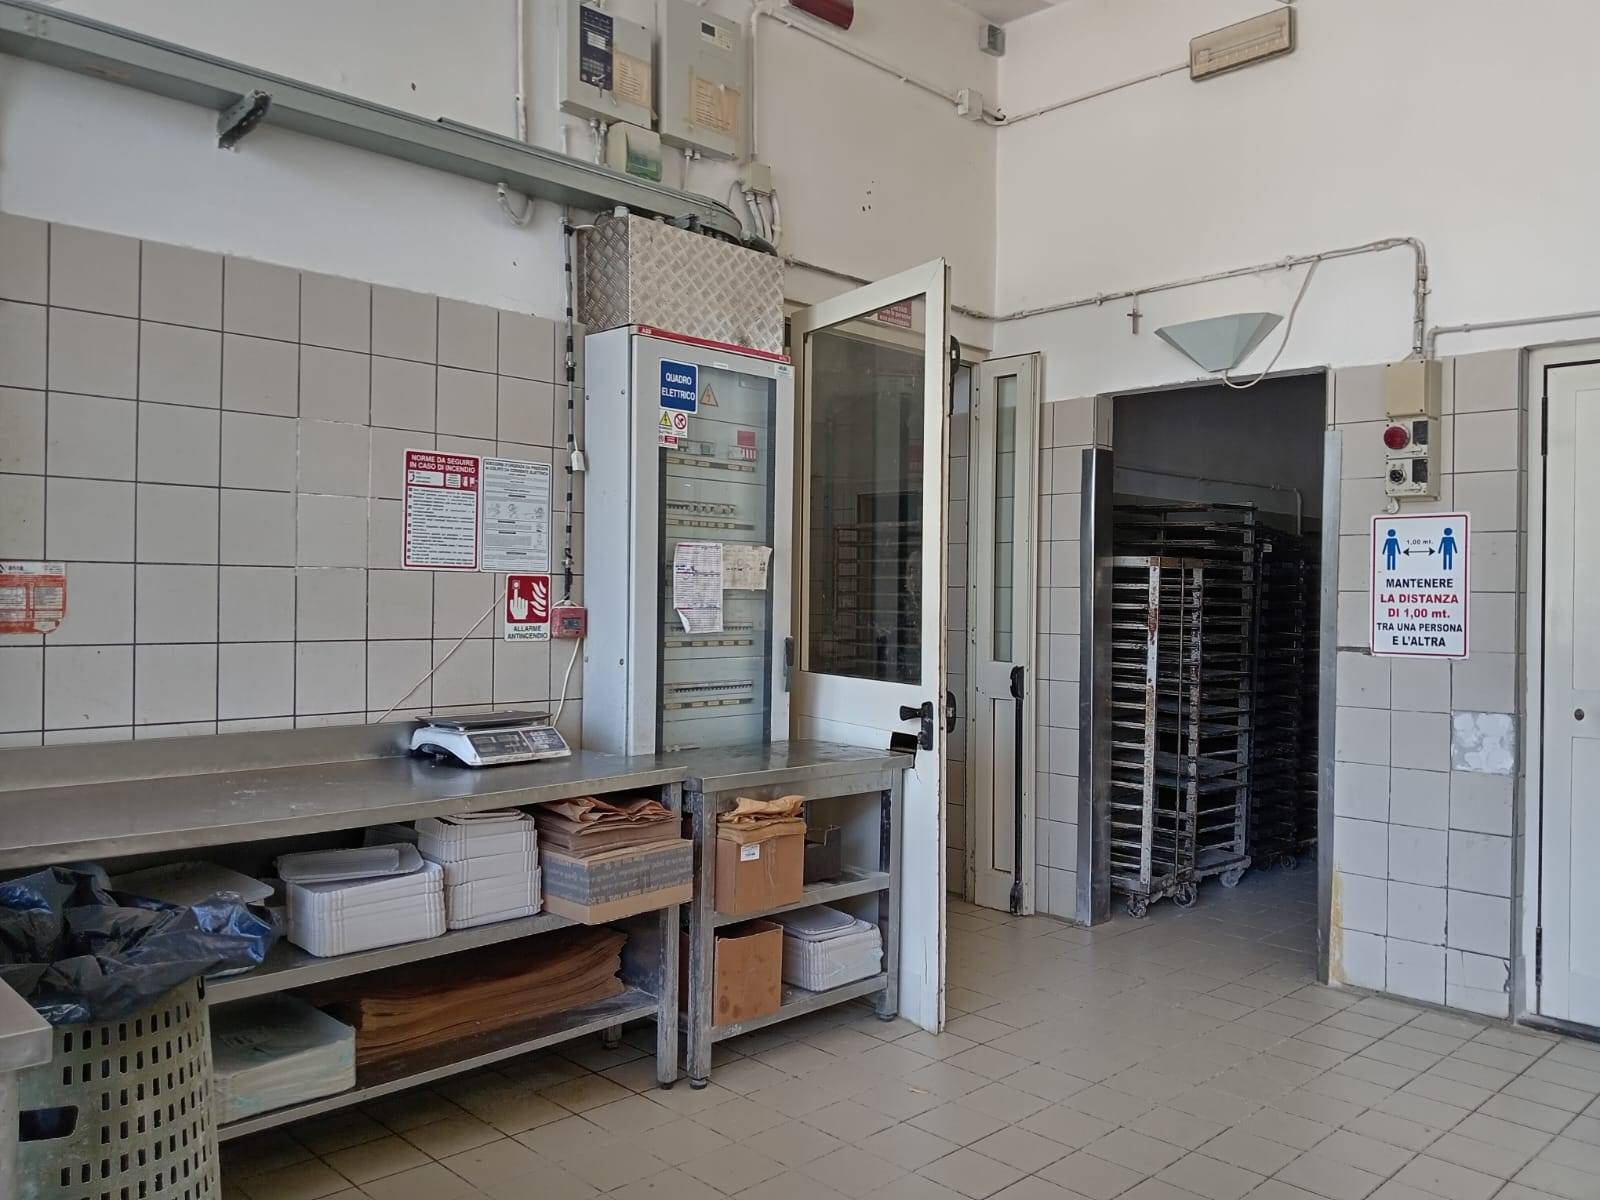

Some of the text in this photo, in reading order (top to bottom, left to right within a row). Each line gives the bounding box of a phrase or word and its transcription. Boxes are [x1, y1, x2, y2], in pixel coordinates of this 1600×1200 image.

[665, 372, 692, 385] QUADRO
[661, 387, 696, 401] ELETTRICO
[411, 454, 436, 462] NORME
[447, 457, 475, 466] SEGUIRE
[418, 461, 437, 469] CASO
[445, 464, 476, 473] INCENDIO
[1386, 578, 1454, 588] MANTENERE
[1380, 594, 1459, 603] LA DISTANZA
[1388, 608, 1450, 619] DI 1,00 mt.
[1376, 622, 1463, 632] TRA UNA PERSONA
[1392, 636, 1446, 647] E L'ALTRA
